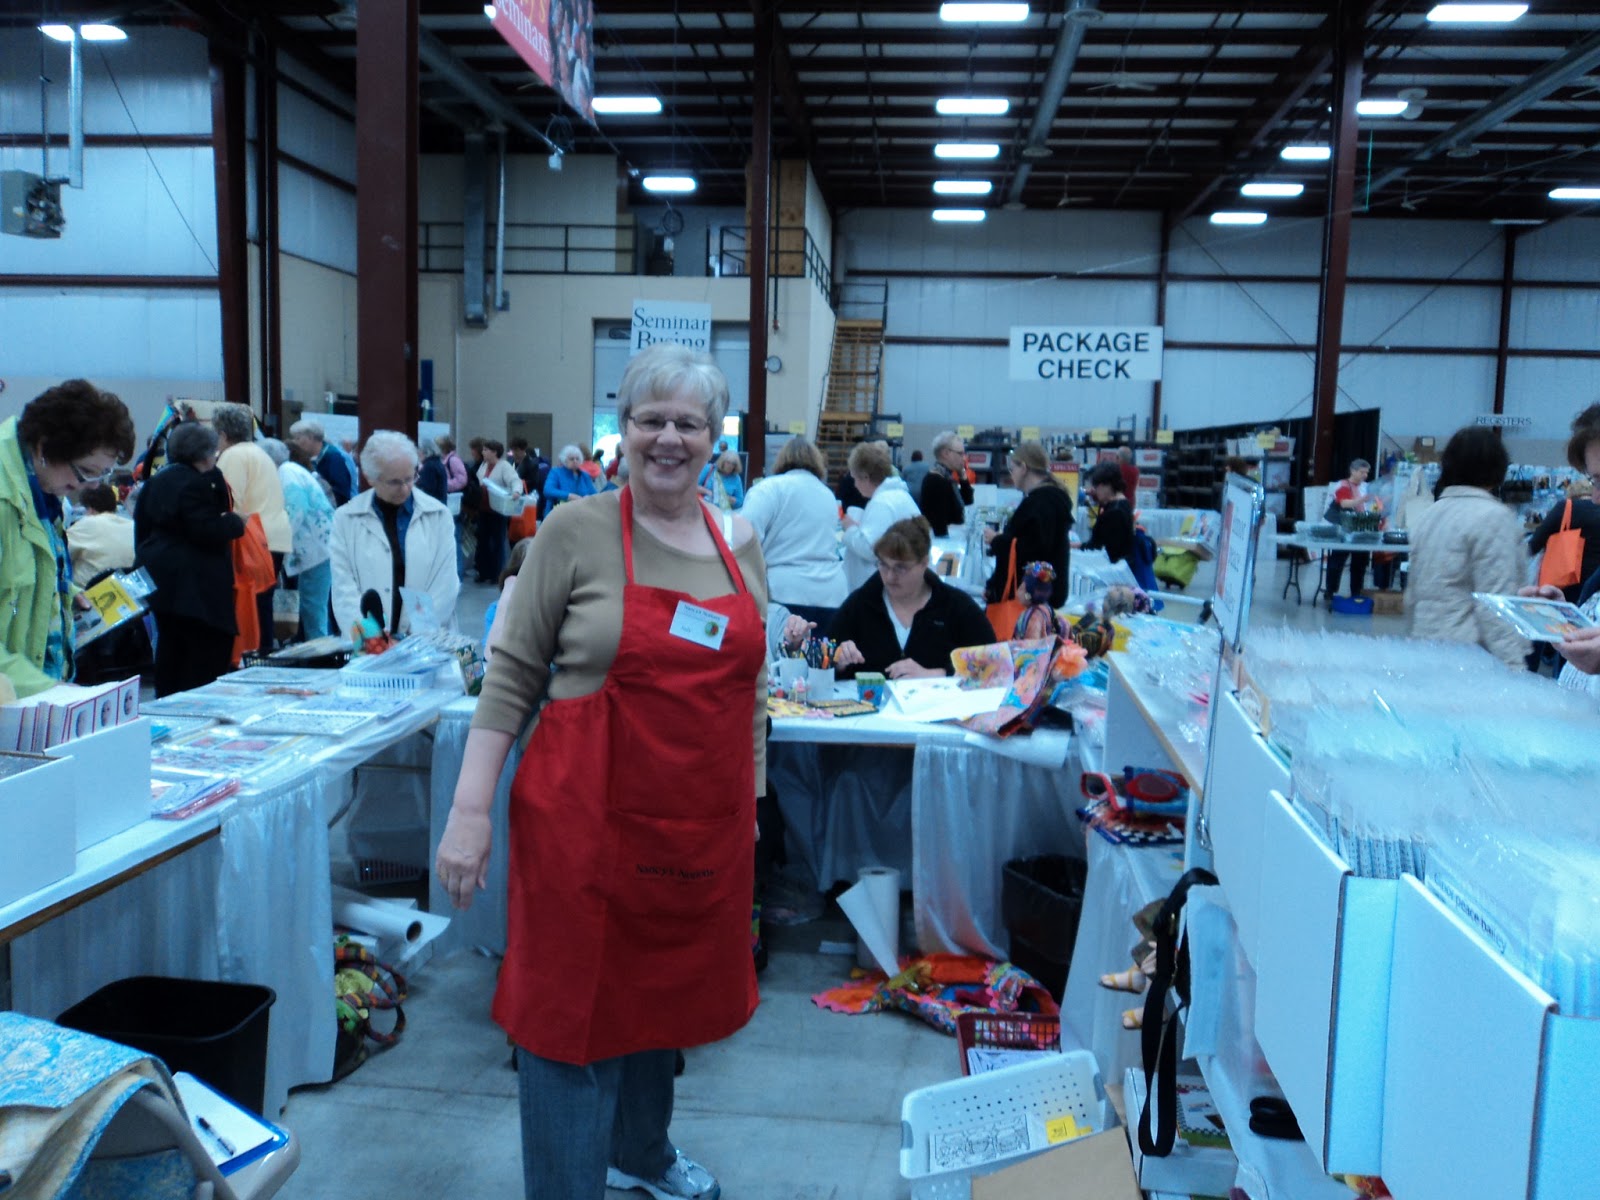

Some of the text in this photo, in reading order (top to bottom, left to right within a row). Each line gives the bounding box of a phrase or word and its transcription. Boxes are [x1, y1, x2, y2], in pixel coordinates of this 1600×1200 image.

[633, 306, 710, 330] Seminar
[637, 330, 705, 350] Bing
[1022, 332, 1150, 353] PACKAGE
[1037, 358, 1132, 379] CHECK
[1475, 415, 1533, 426] REGISTERS
